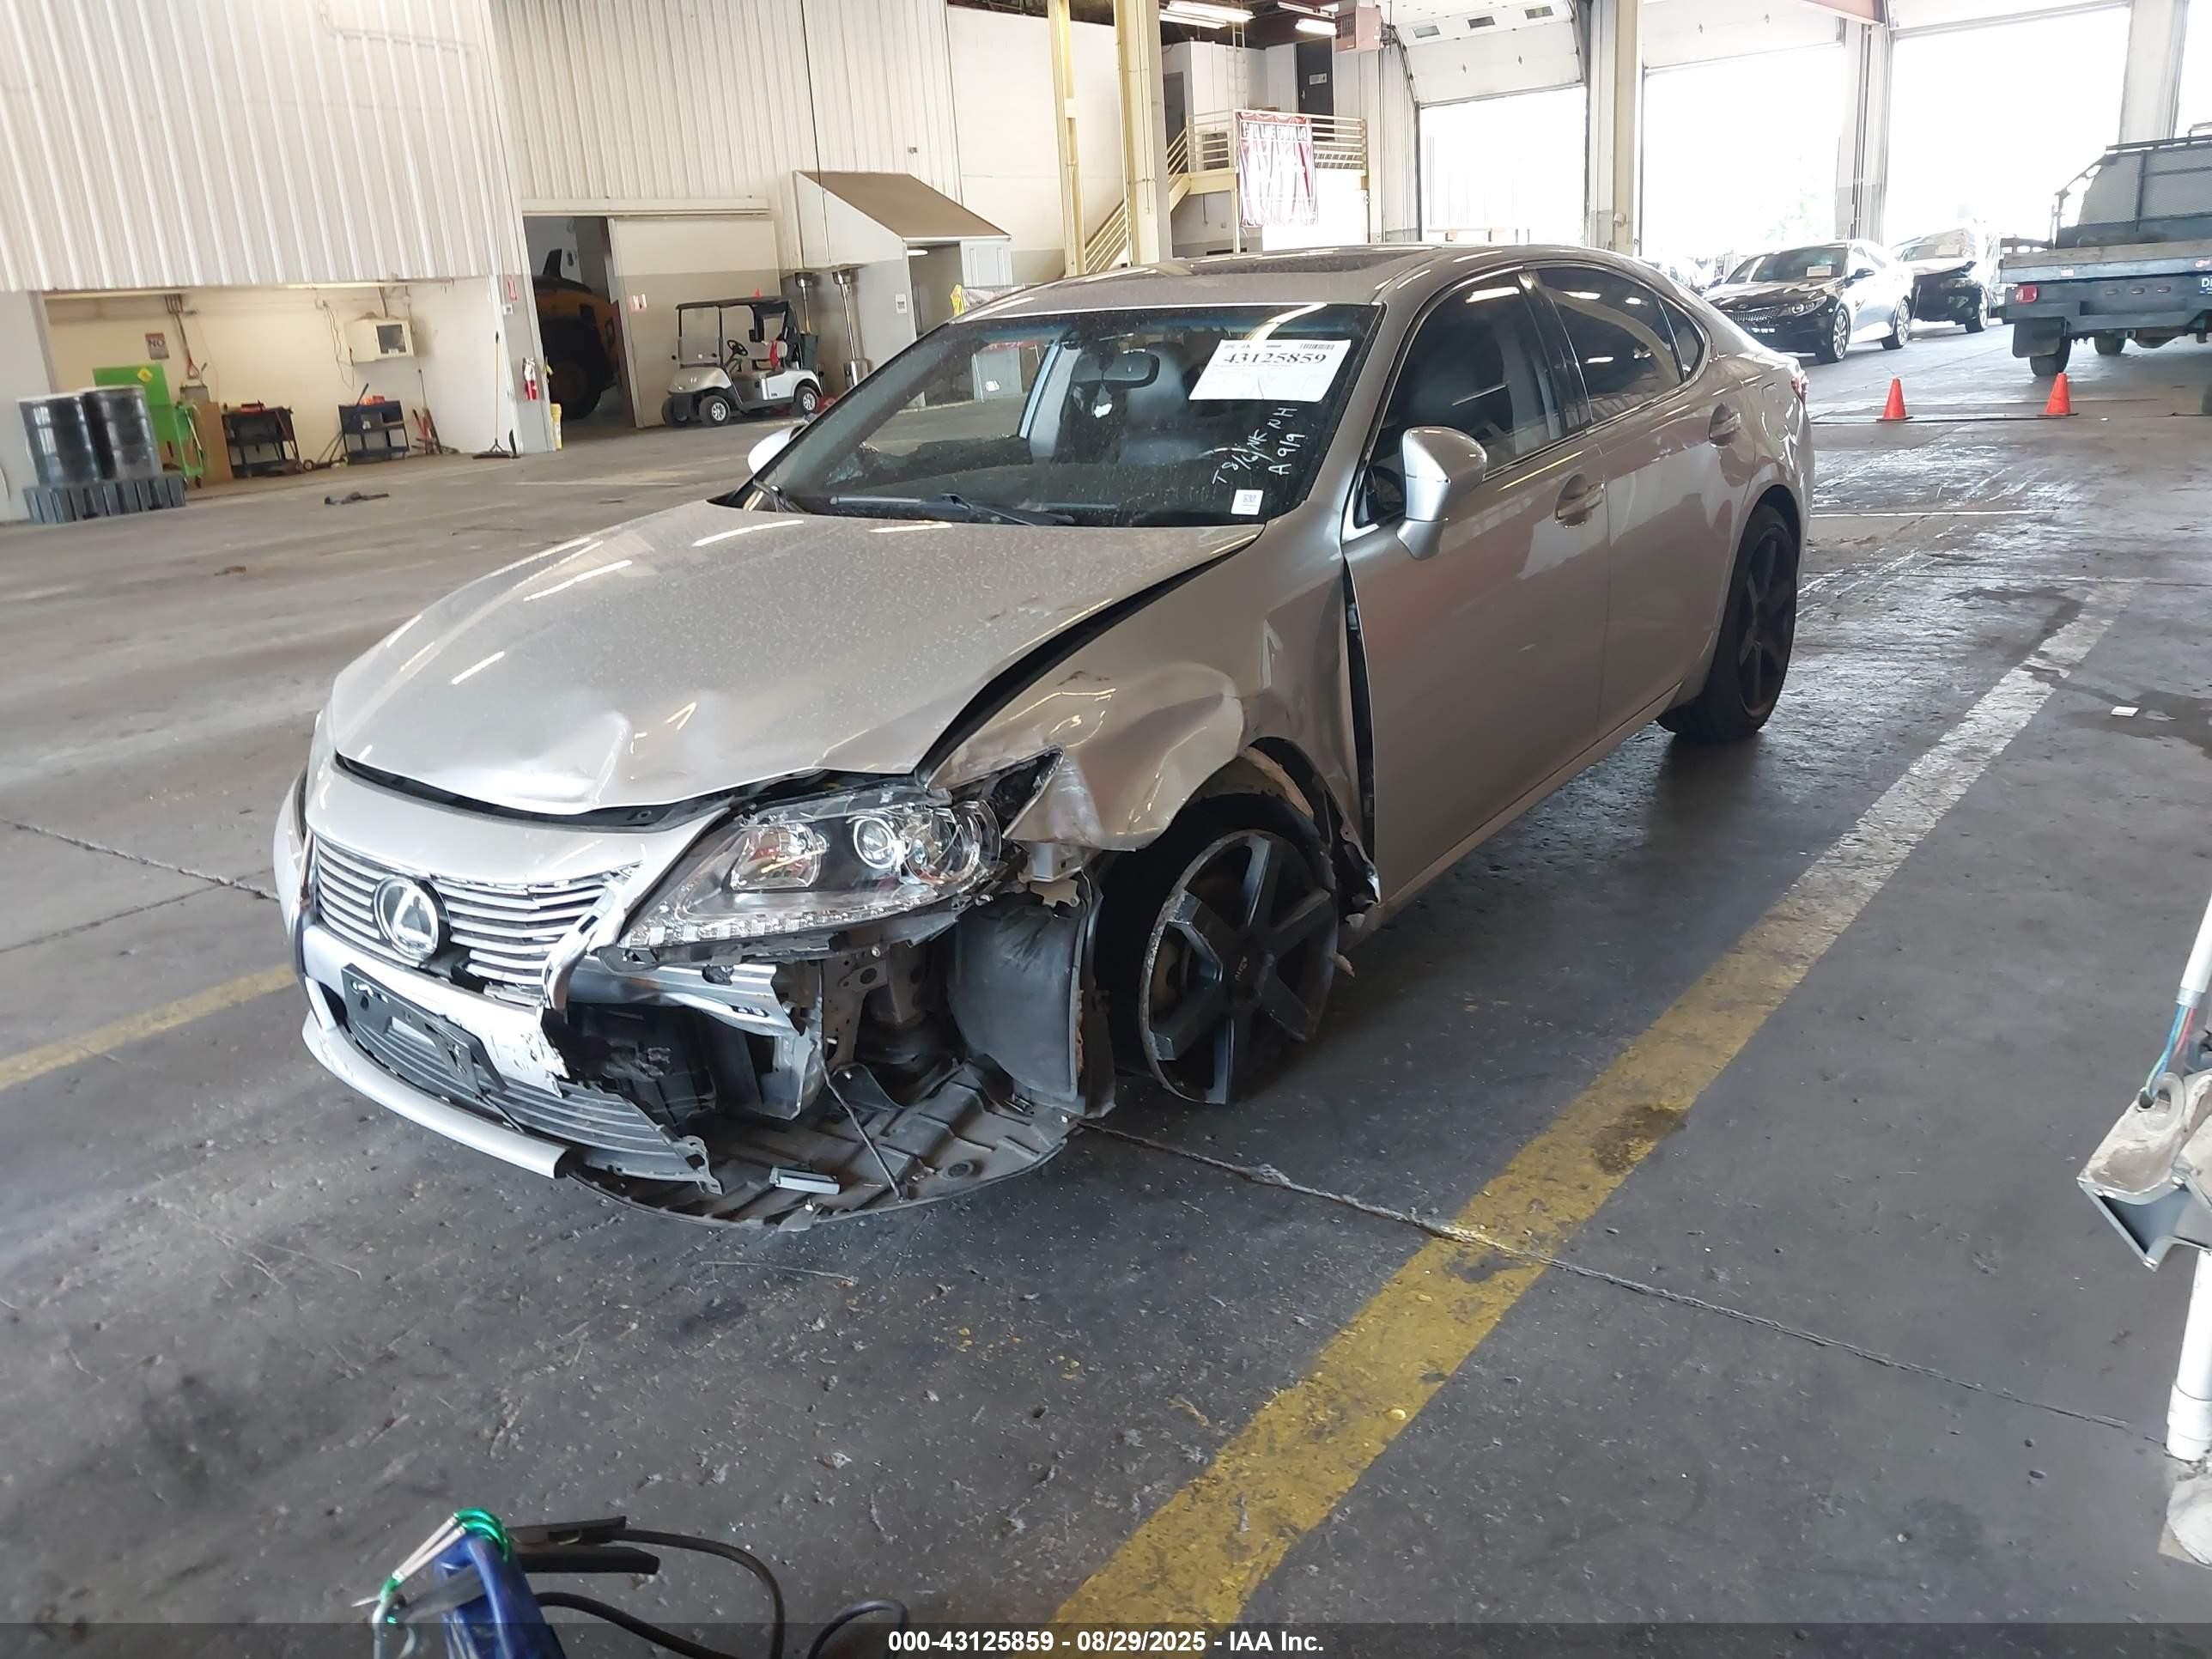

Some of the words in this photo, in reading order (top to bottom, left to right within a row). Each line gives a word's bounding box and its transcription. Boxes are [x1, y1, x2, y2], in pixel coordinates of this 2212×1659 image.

[1224, 352, 1327, 364] 43125859
[1277, 433, 1306, 457] 9/9
[1267, 463, 1292, 476] A
